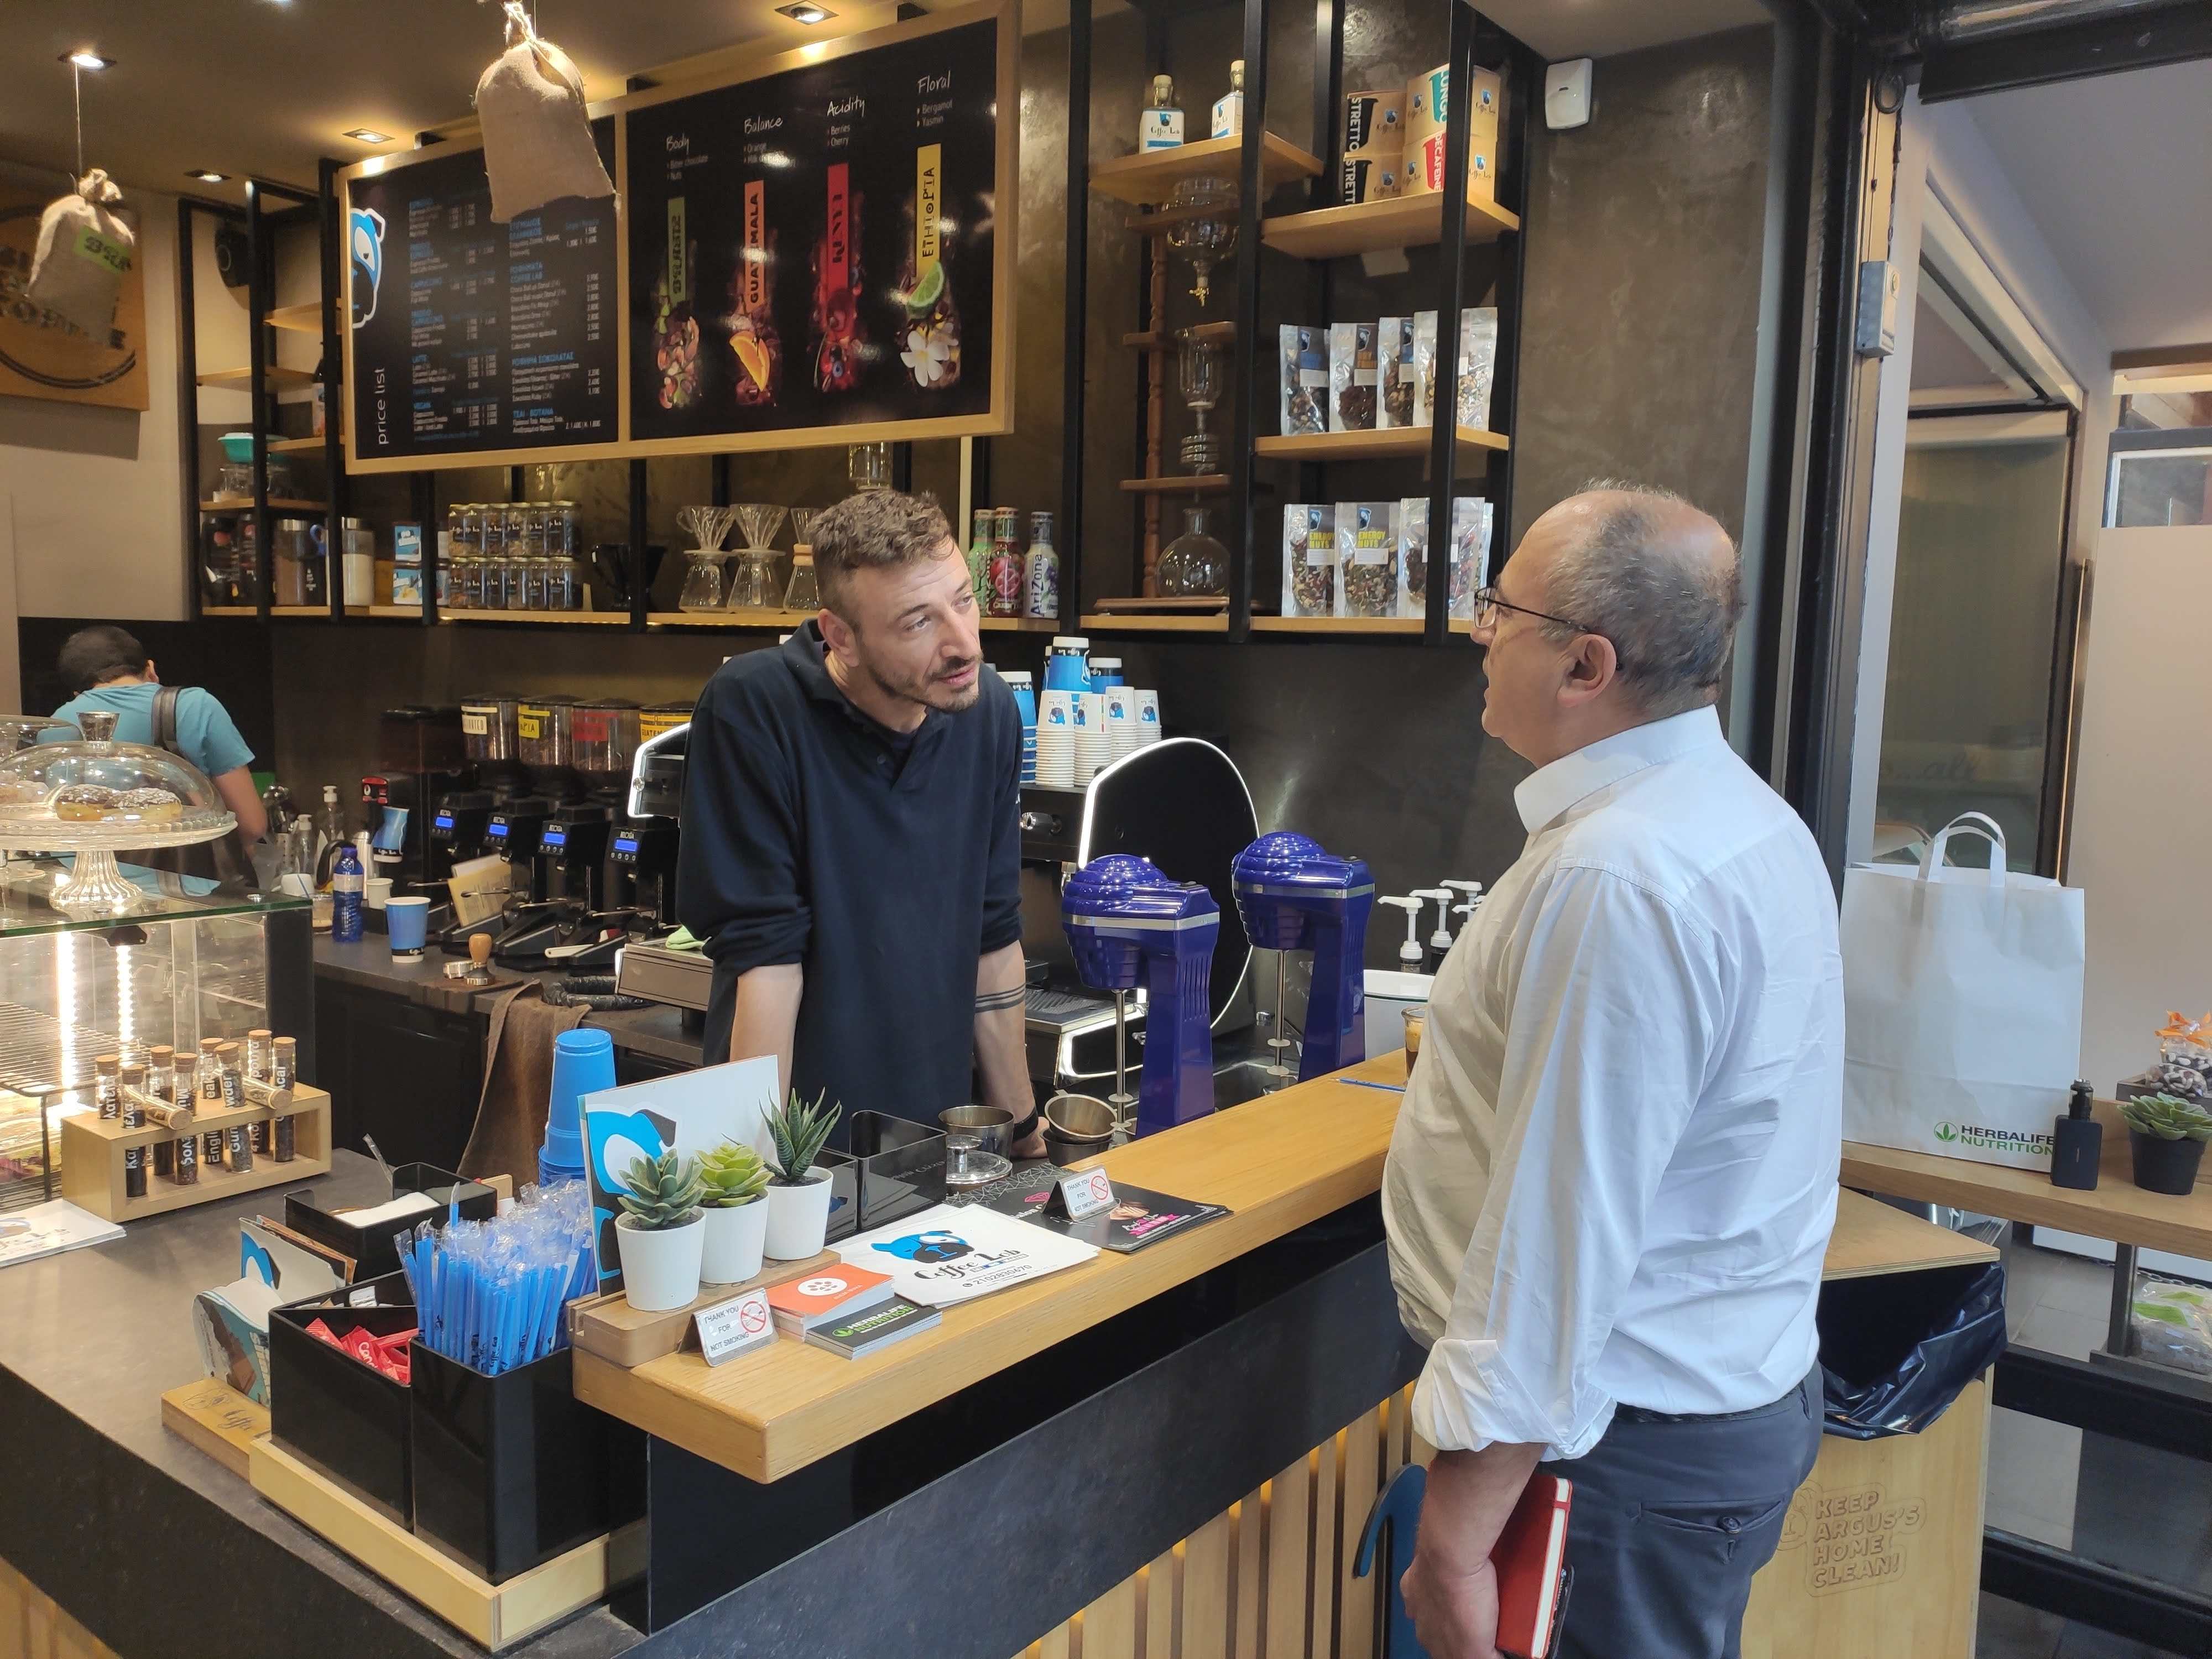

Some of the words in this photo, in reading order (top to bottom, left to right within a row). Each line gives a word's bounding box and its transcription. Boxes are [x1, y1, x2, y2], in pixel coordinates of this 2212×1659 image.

[917, 70, 951, 93] Floral
[827, 95, 865, 117] Acidity
[744, 116, 782, 134] Balance
[666, 133, 689, 155] Body
[922, 167, 935, 257] ETHIOPIA
[750, 194, 759, 304] GUATMALA
[374, 368, 385, 394] list
[375, 399, 389, 445] price
[1031, 554, 1045, 617] AriZona
[208, 1131, 220, 1163] Engli
[1961, 1125, 2054, 1145] HERBALIFE
[1961, 1135, 2053, 1155] NUTRITION
[1067, 1182, 1081, 1191] THANK
[914, 1261, 978, 1279] Coffee
[974, 1249, 1021, 1261] Lab
[705, 1310, 726, 1323] THANK
[726, 1305, 739, 1314] YOU
[847, 1304, 907, 1329] HERBALIFE
[853, 1306, 914, 1332] NUTRITION
[718, 1323, 732, 1333] FOR
[710, 1342, 723, 1352] NOT
[724, 1332, 749, 1346] SMOKING
[1815, 1491, 1879, 1519] KEEP
[1814, 1505, 1920, 1542] ARGUS'S
[1814, 1535, 1884, 1566] HOME
[1812, 1553, 1900, 1588] CLEAN!
